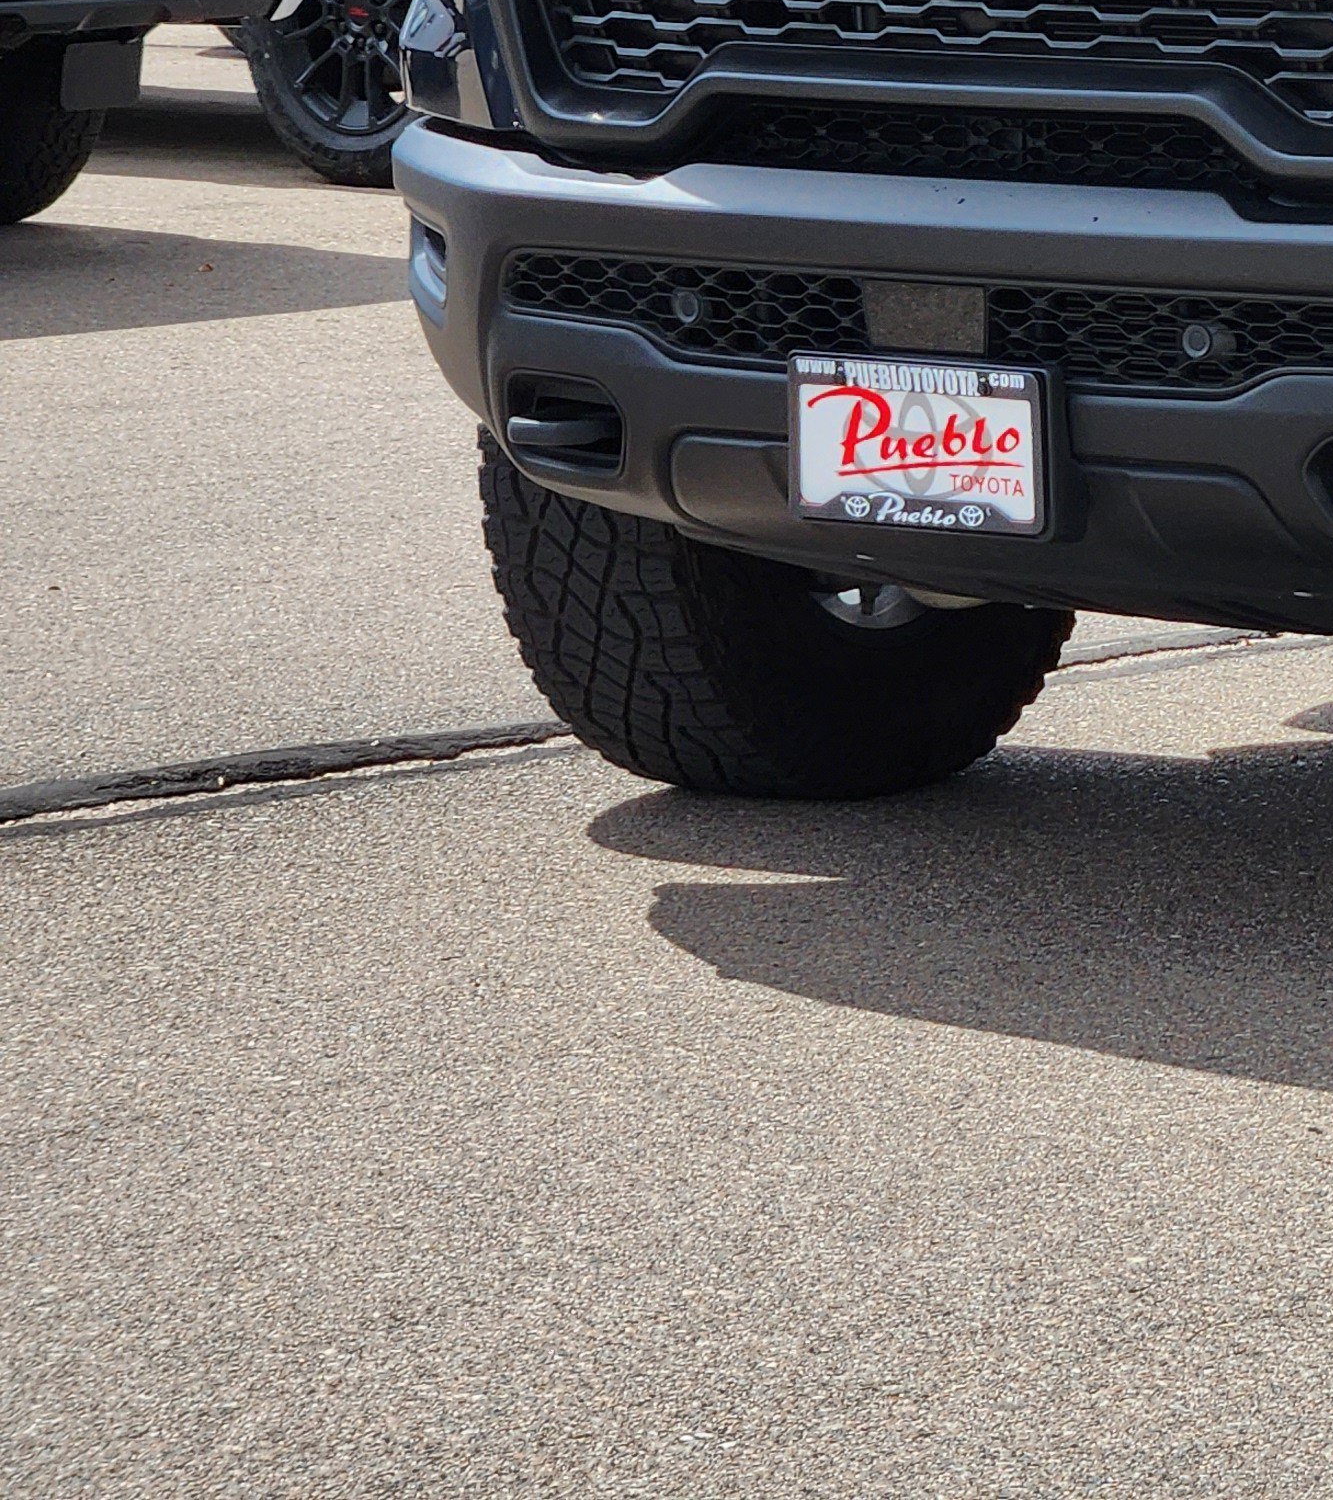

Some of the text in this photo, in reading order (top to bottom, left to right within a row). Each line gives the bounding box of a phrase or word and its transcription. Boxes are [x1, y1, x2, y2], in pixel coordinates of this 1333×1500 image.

[807, 385, 1021, 467] Pueblo
[949, 473, 1025, 497] TOYOTA
[868, 491, 957, 527] Pueblo
